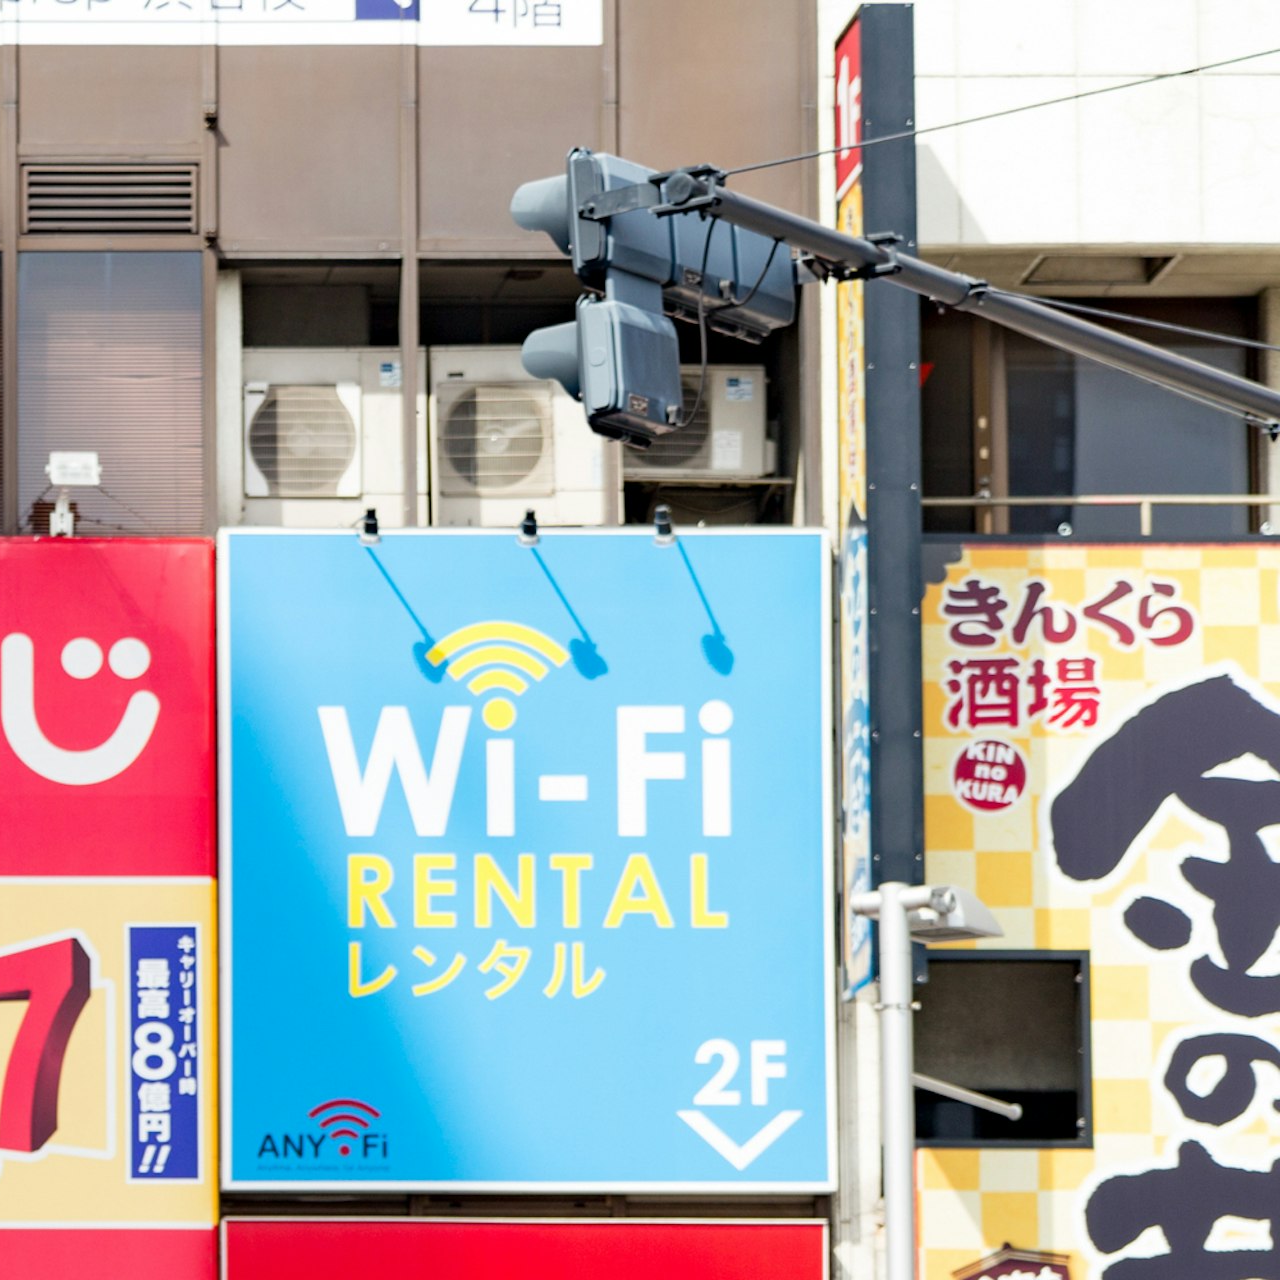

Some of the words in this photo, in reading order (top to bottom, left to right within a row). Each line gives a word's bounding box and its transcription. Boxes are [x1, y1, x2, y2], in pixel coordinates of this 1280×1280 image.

[942, 578, 1196, 648] きんくら
[945, 656, 1102, 729] 酒場
[316, 698, 734, 838] Wi-Fi
[965, 742, 1016, 766] KIN
[973, 762, 1008, 782] no
[956, 778, 1019, 805] KURA
[346, 852, 730, 929] RENTAL
[347, 938, 607, 1001] レンタル
[692, 1037, 789, 1107] 2F
